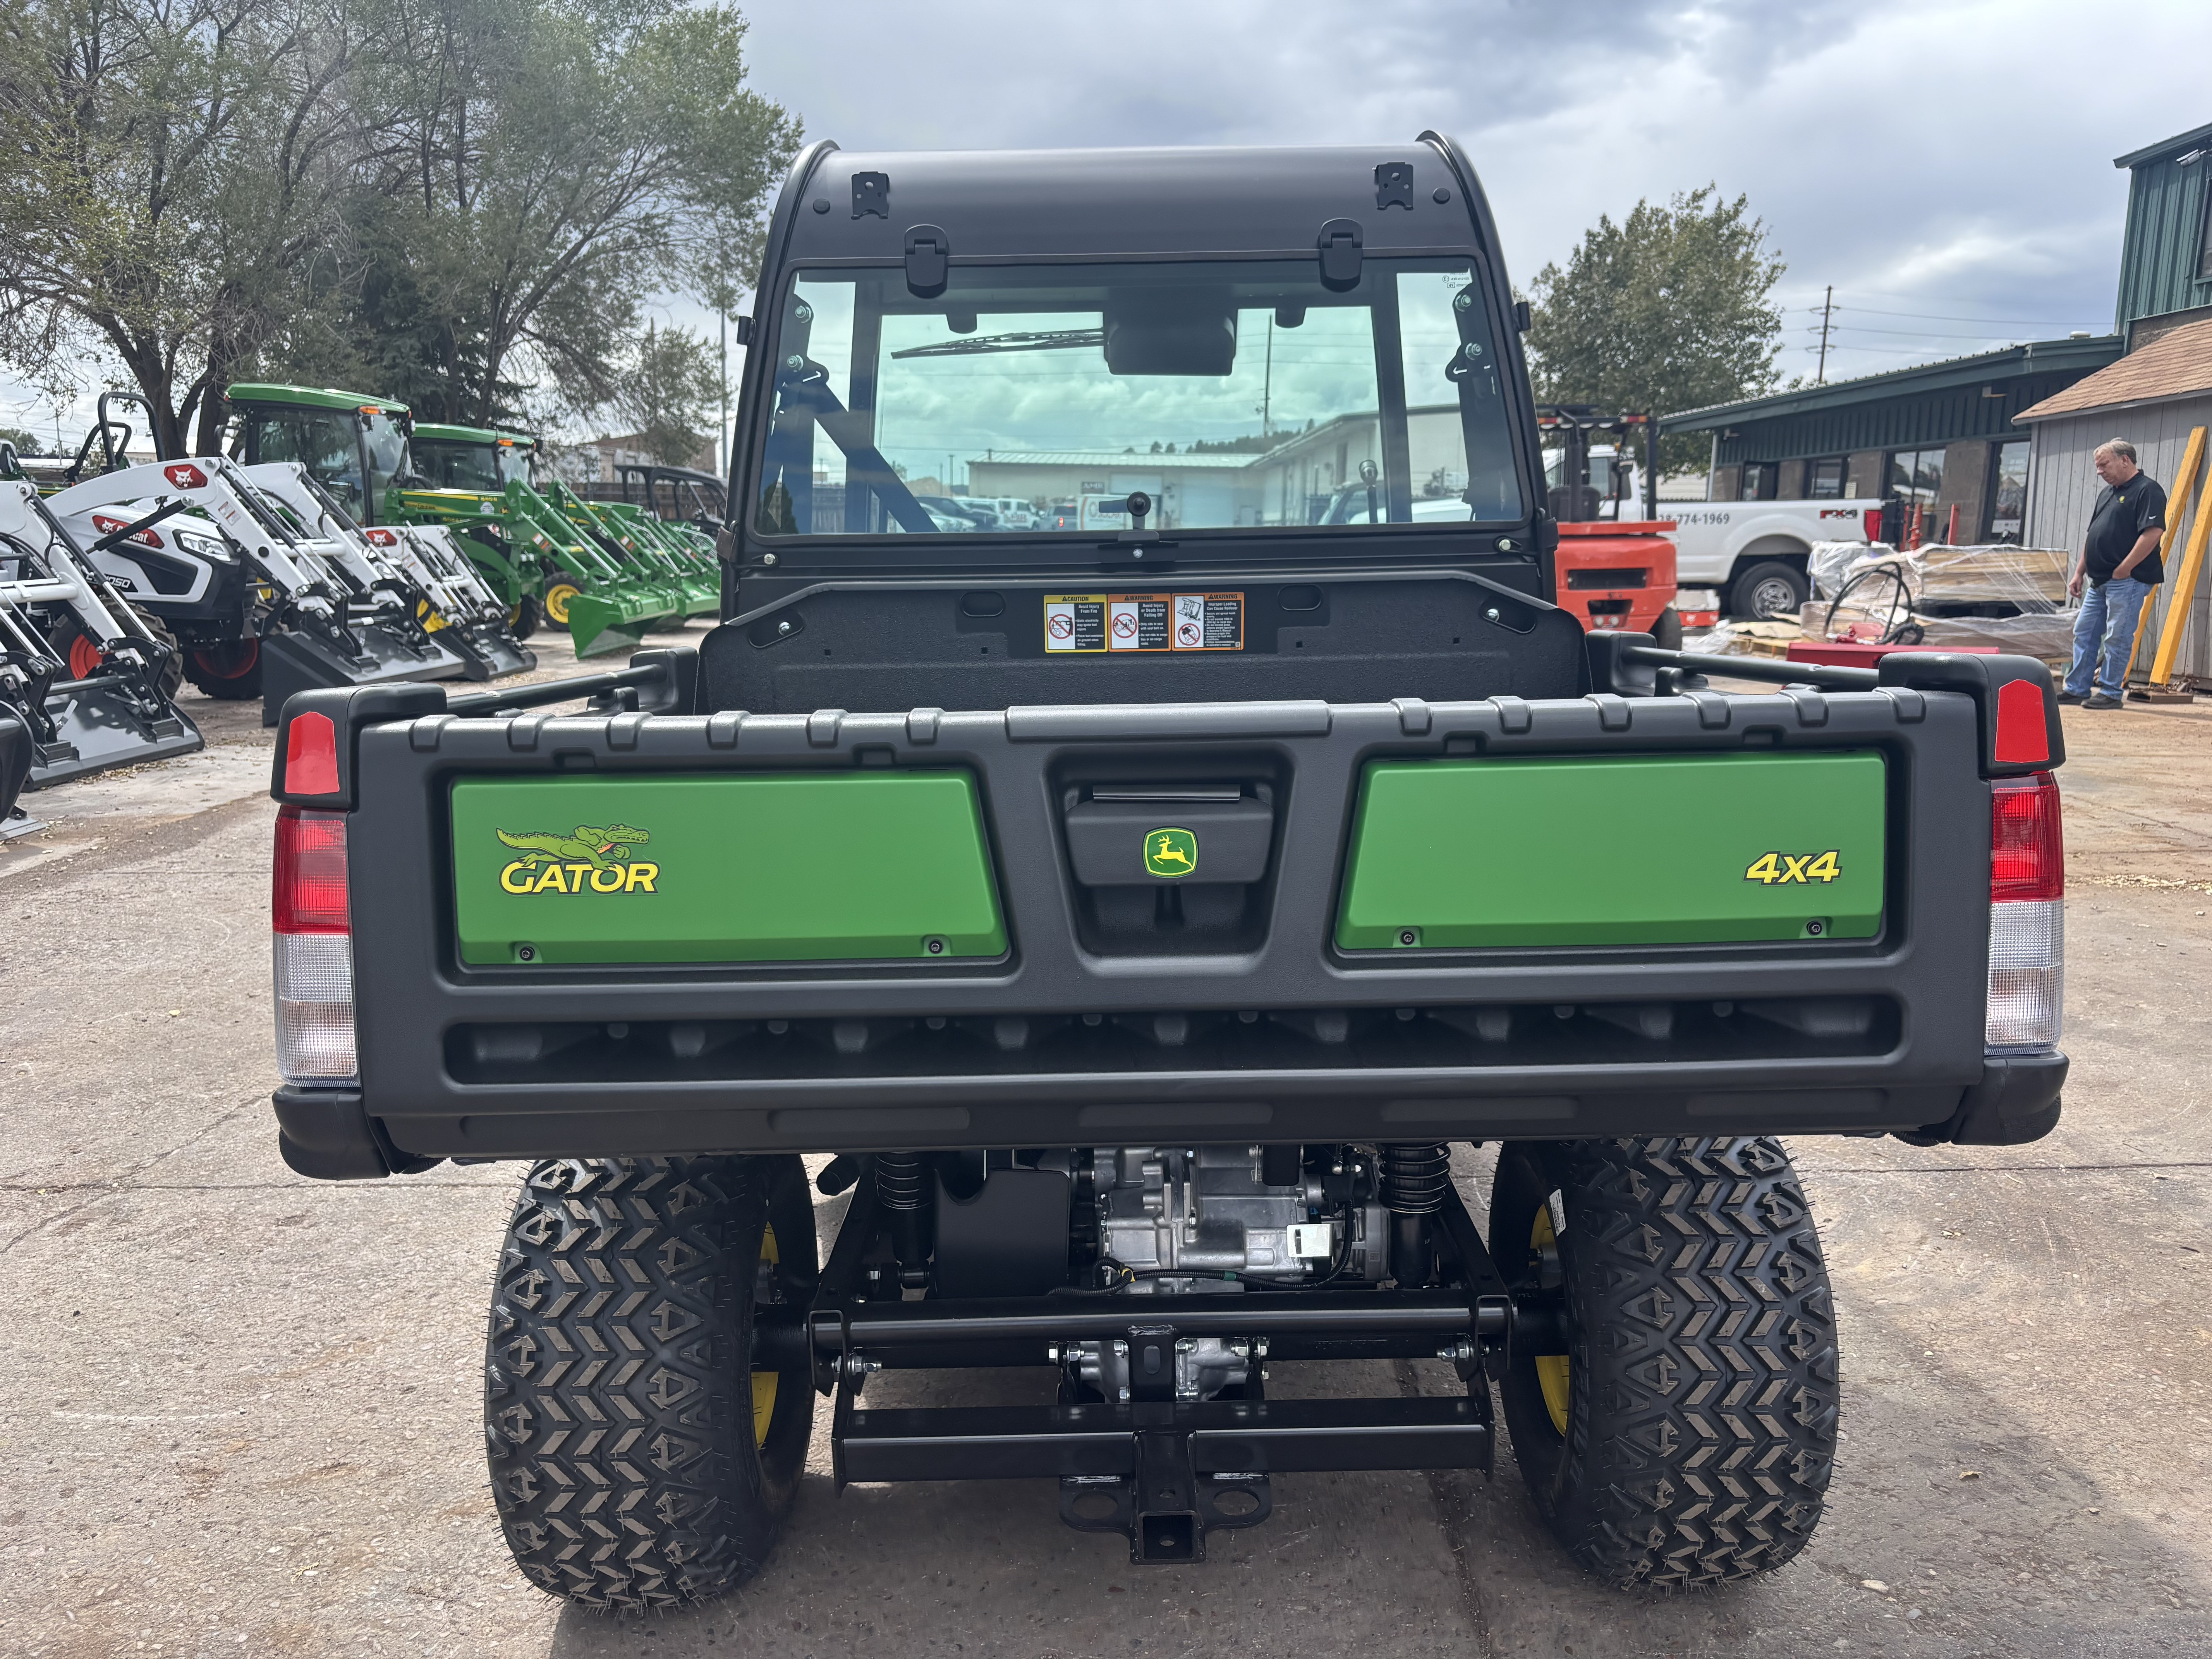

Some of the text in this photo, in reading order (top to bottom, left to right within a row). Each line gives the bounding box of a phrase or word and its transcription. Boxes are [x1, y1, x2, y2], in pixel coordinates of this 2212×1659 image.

[1659, 513, 1729, 525] 28-774-1969
[1820, 510, 1858, 519] FX4
[500, 861, 660, 895] GATOR
